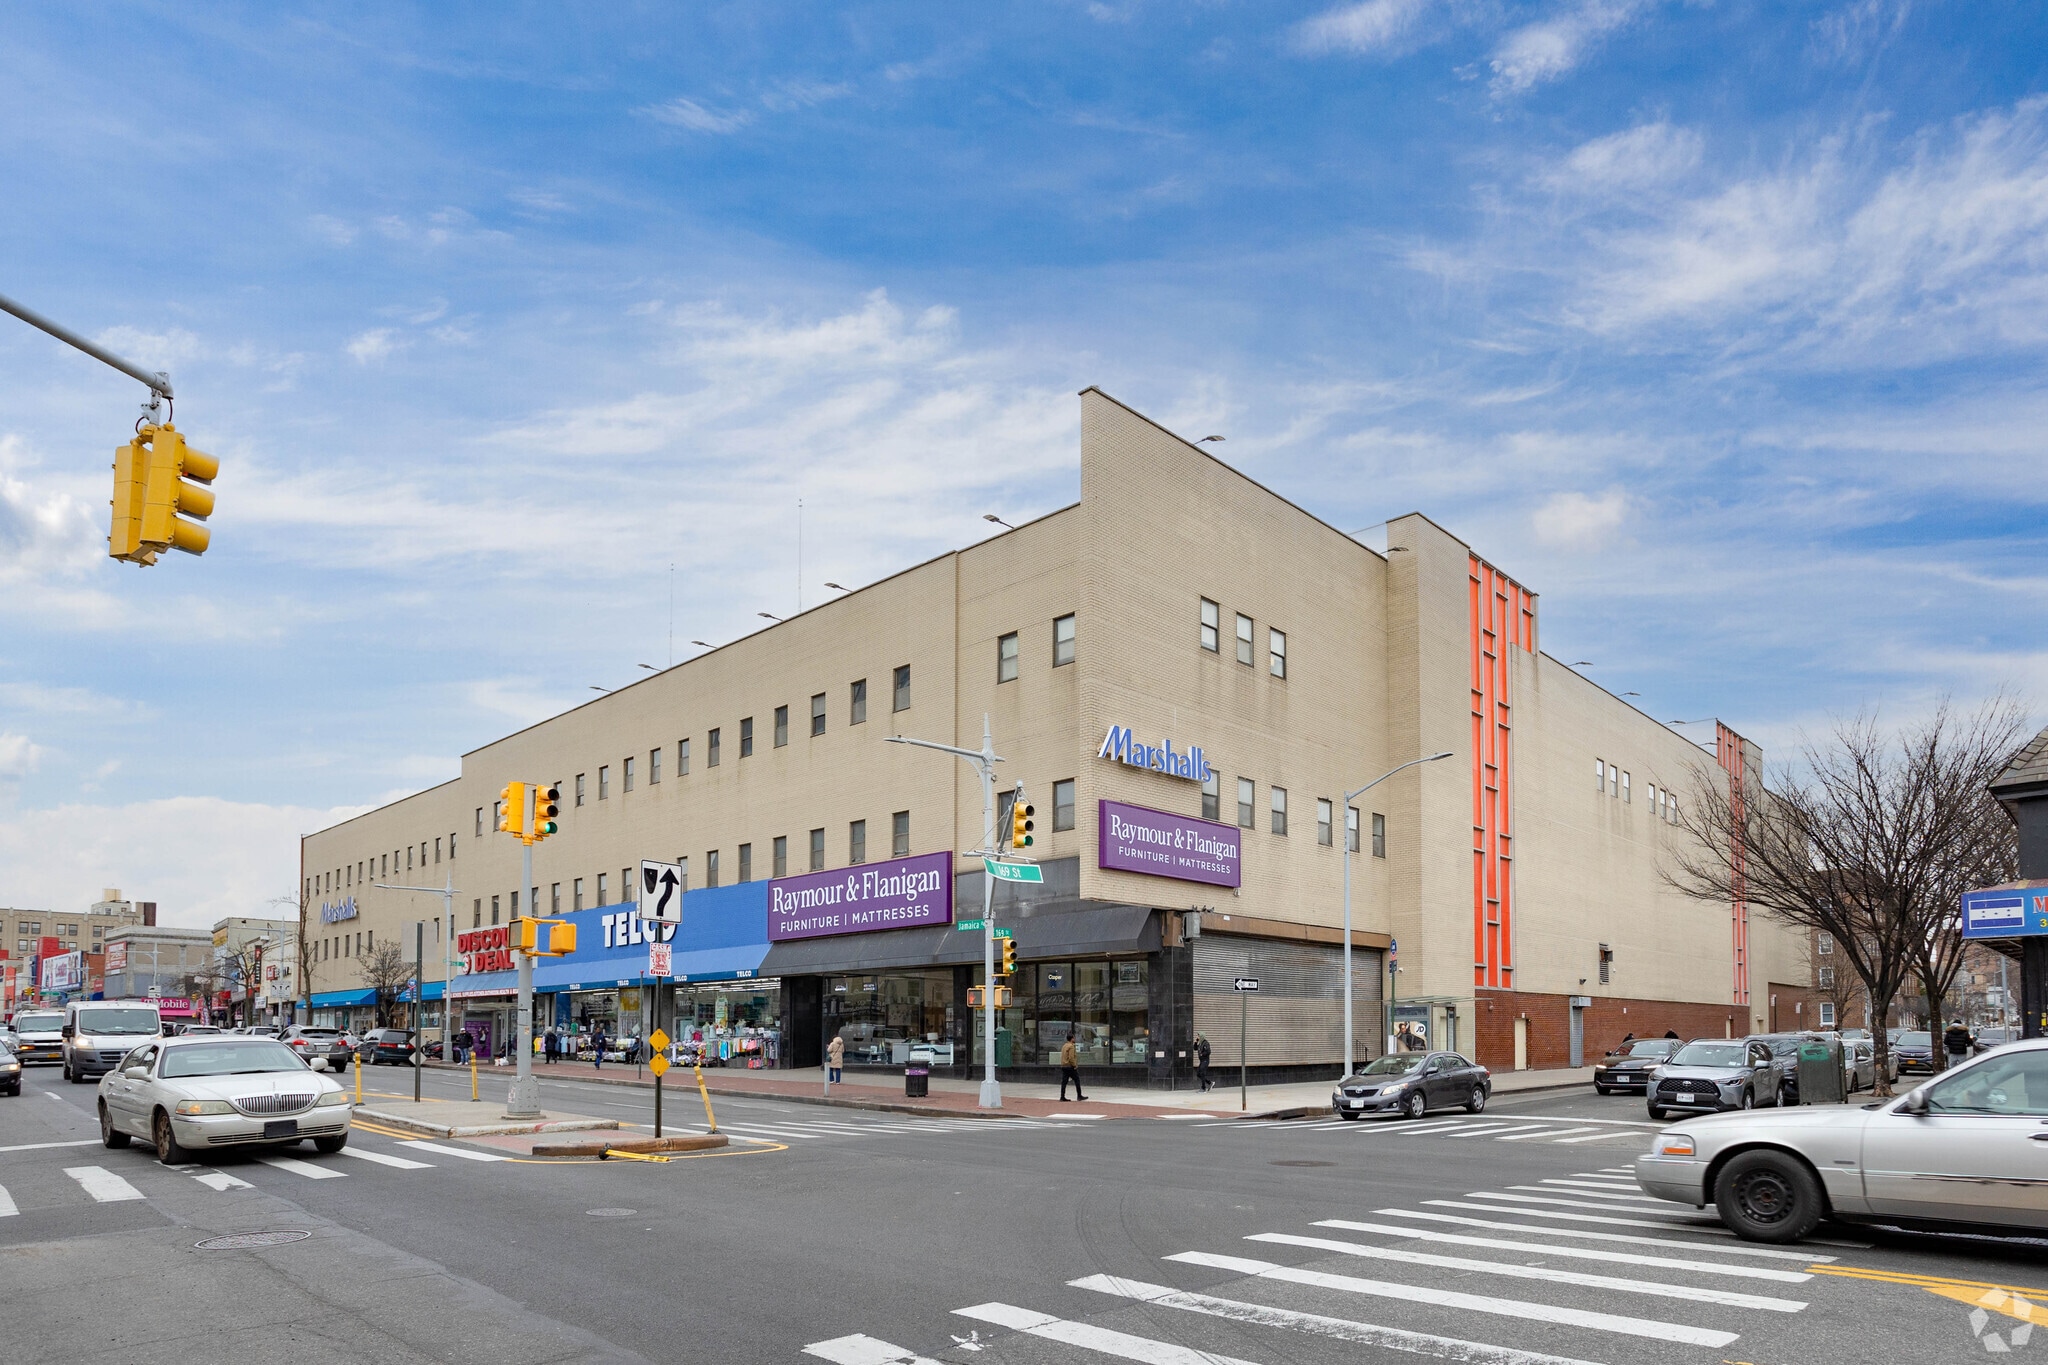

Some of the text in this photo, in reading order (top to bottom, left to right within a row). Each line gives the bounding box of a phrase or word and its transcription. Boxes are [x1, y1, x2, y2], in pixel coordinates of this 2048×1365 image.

[1099, 725, 1212, 783] Marshalls
[1110, 814, 1237, 861] Raymour & Flanigan
[998, 866, 1022, 878] 169 St
[1118, 846, 1231, 874] FURNITURE MATTRESSES
[772, 867, 940, 916] Raymour & Flanigan
[319, 896, 358, 924] Marshalls
[780, 904, 930, 933] FURNITURE MATTRESSES
[958, 921, 980, 931] Jamaica
[996, 929, 1005, 937] 169
[475, 949, 515, 972] DEAL
